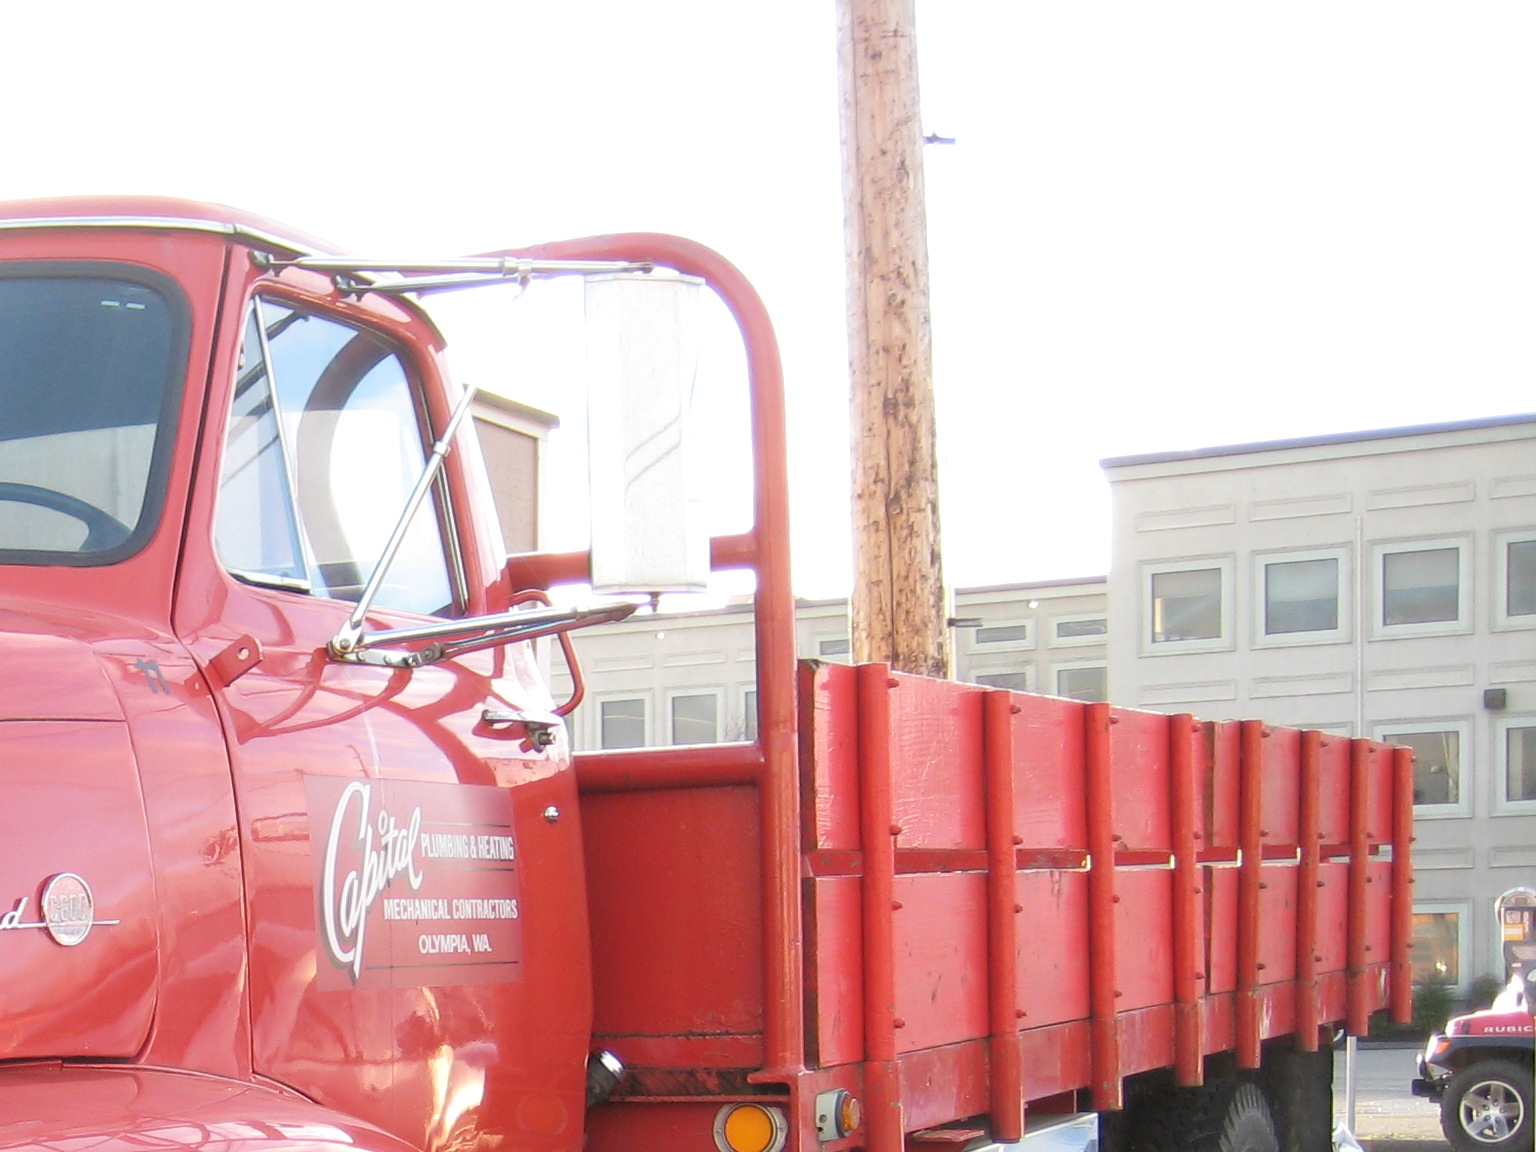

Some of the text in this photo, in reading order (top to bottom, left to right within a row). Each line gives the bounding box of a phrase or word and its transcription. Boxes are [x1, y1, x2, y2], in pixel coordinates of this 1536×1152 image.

[422, 833, 514, 860] PLUMBING & HEATING
[322, 780, 423, 979] Capital
[384, 898, 518, 920] MECHANICAL CONTRACTORS
[418, 933, 492, 955] OLYMPIA, WA.
